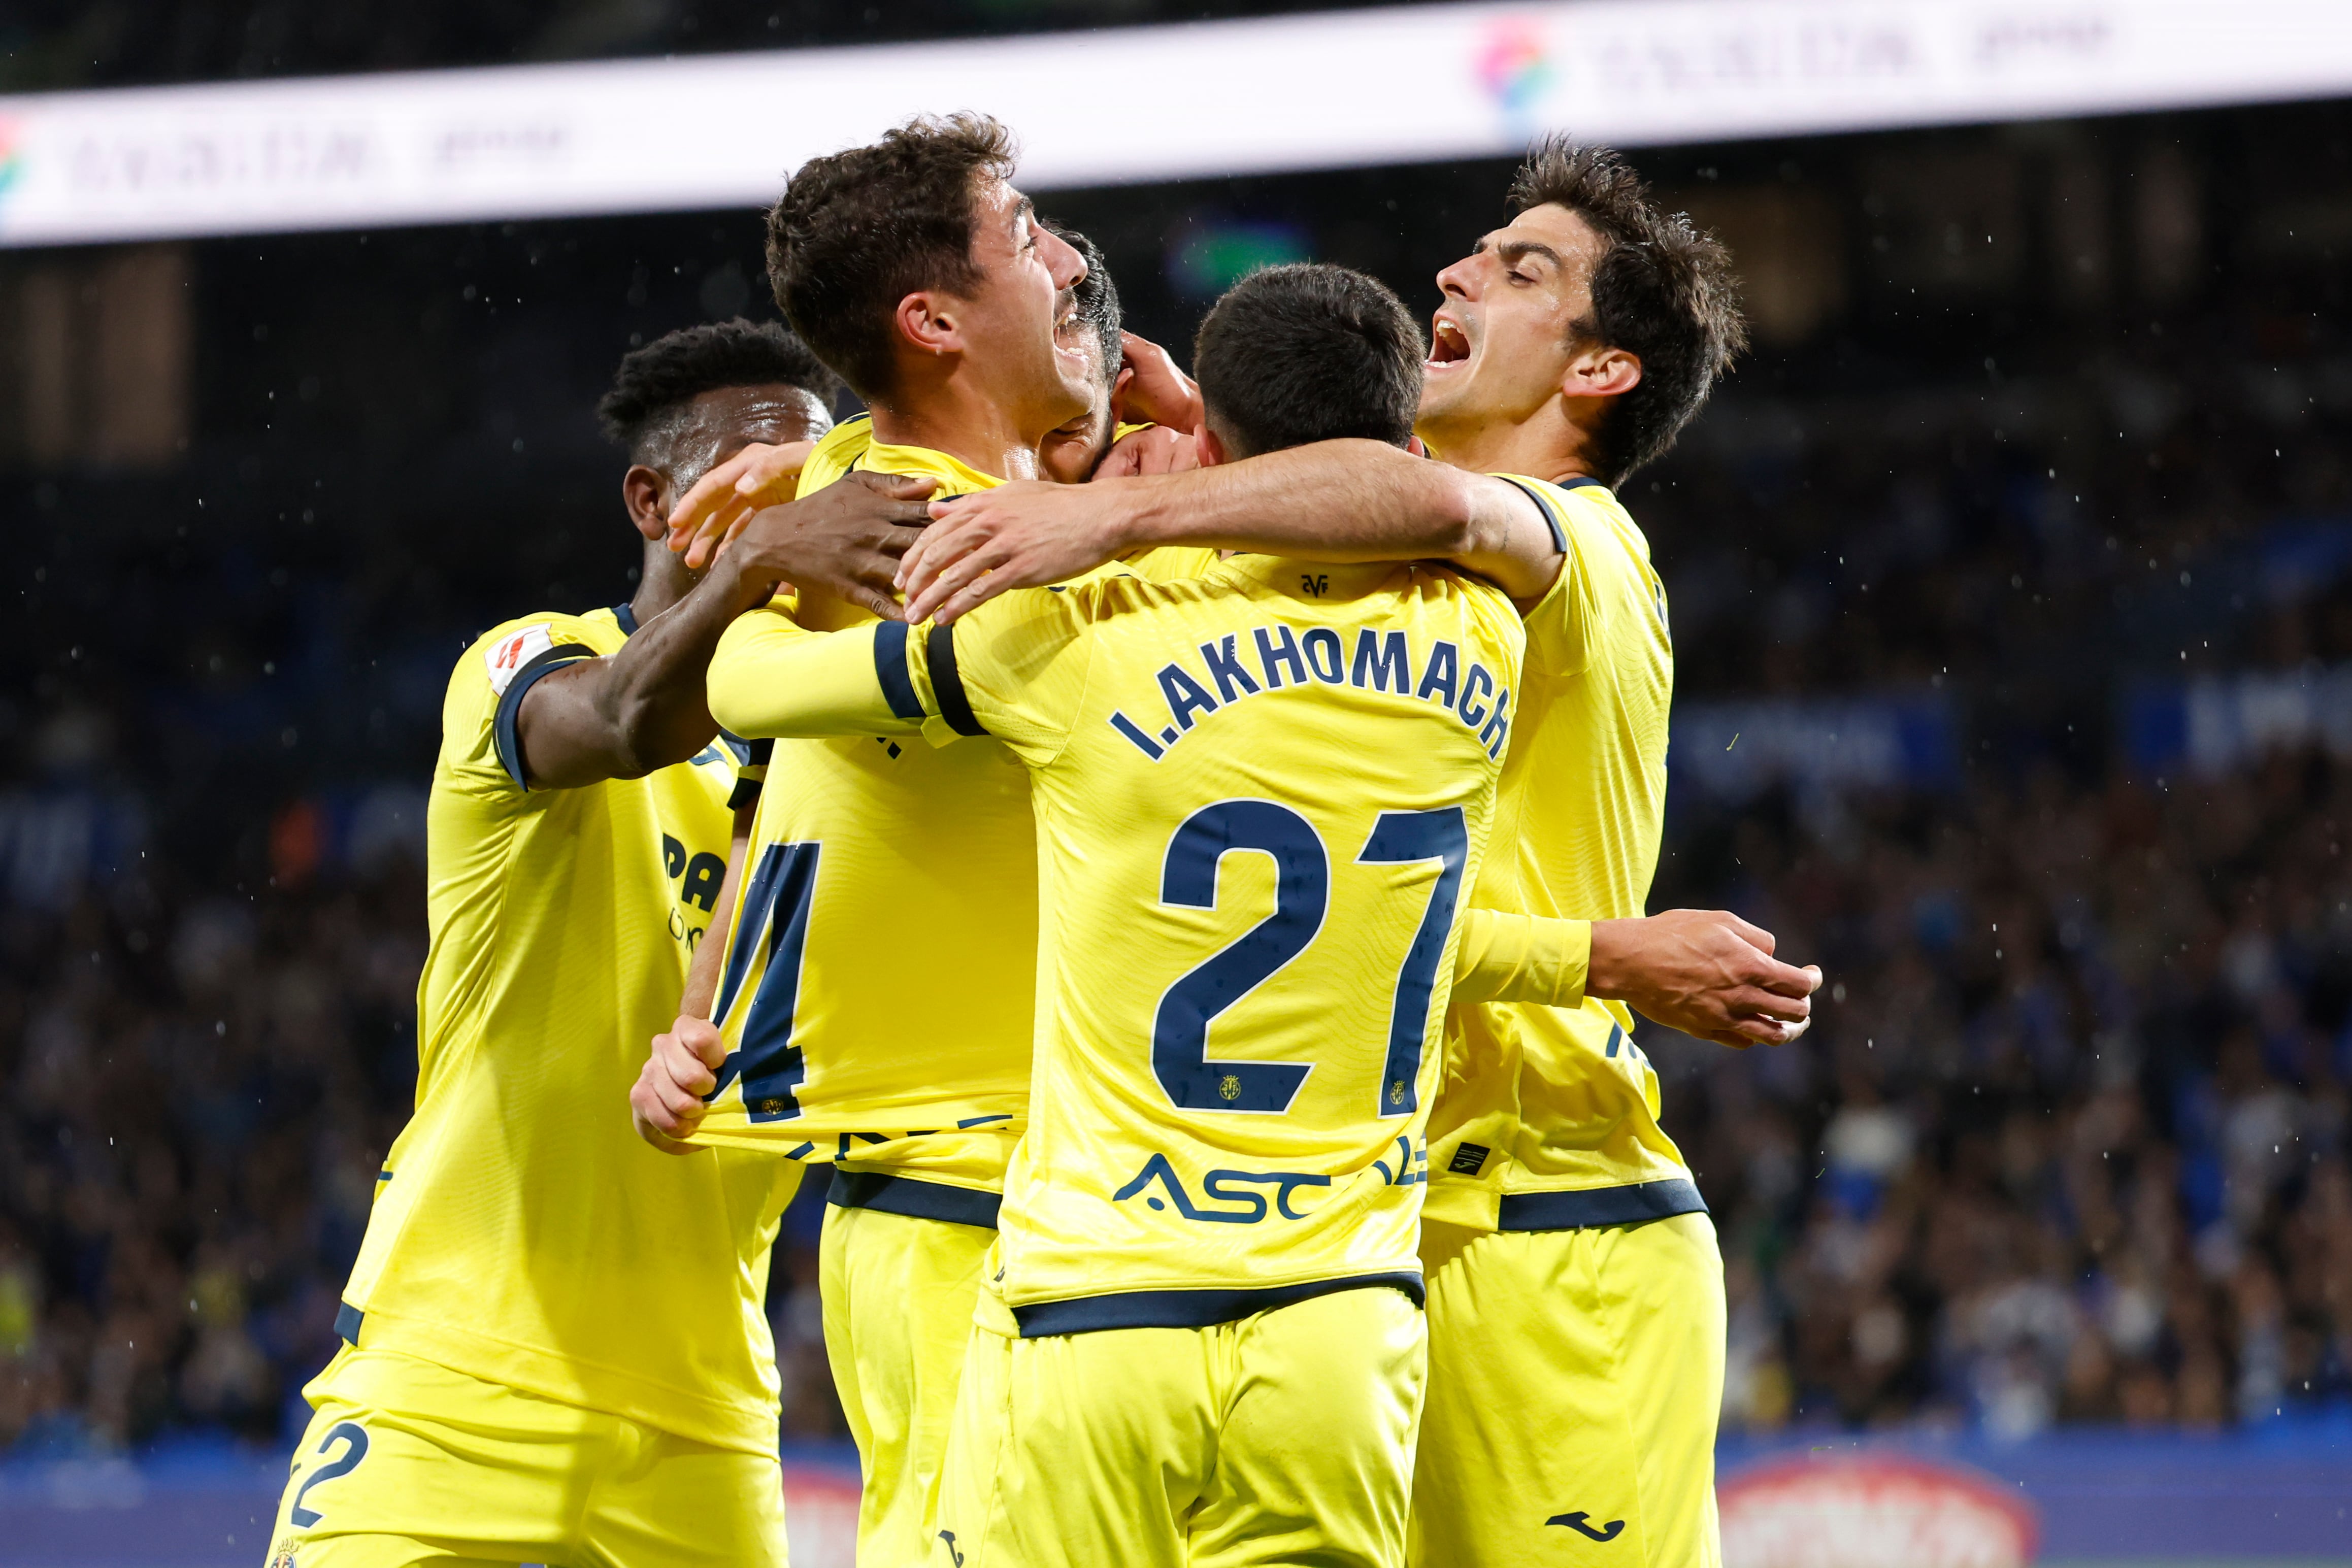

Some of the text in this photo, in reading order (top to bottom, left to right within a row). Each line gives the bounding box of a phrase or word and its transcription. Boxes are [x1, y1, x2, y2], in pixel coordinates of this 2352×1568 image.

[1107, 623, 1510, 763] I.AKHOMACH
[701, 840, 823, 1124] 4
[1149, 797, 1469, 1119] 27
[289, 1421, 371, 1529] 2
